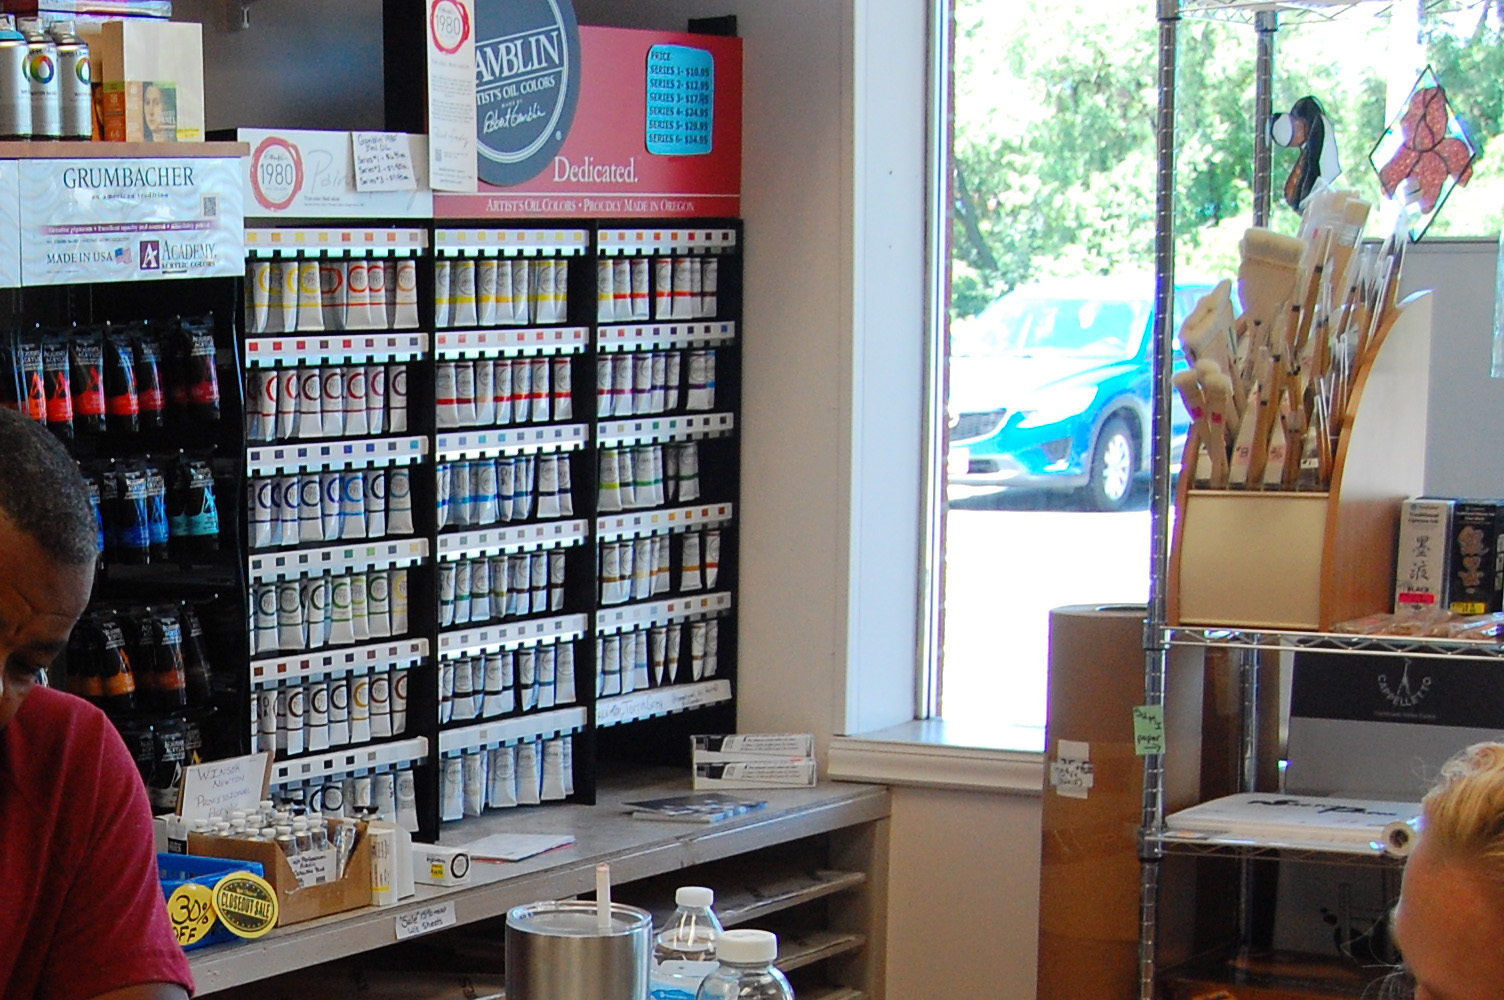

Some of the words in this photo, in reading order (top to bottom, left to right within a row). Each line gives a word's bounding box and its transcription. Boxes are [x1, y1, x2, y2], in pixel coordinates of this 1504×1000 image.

[475, 31, 561, 85] AMBLIN
[503, 83, 518, 100] OIL
[520, 75, 556, 95] COLORS
[63, 166, 194, 189] GRUMBACHER
[260, 162, 293, 187] 1980
[553, 156, 639, 183] Dedicated.
[542, 198, 576, 212] COLORS
[583, 198, 621, 212] PROUDLY
[624, 198, 648, 212] MADE
[649, 199, 659, 212] IN
[660, 199, 695, 212] OREGON
[47, 253, 77, 265] MADE
[79, 252, 90, 264] IN
[93, 251, 113, 262] USA
[1137, 735, 1161, 745] paper
[171, 894, 212, 925] 30%
[221, 891, 254, 914] CLOSEOUT
[255, 900, 271, 919] SALE
